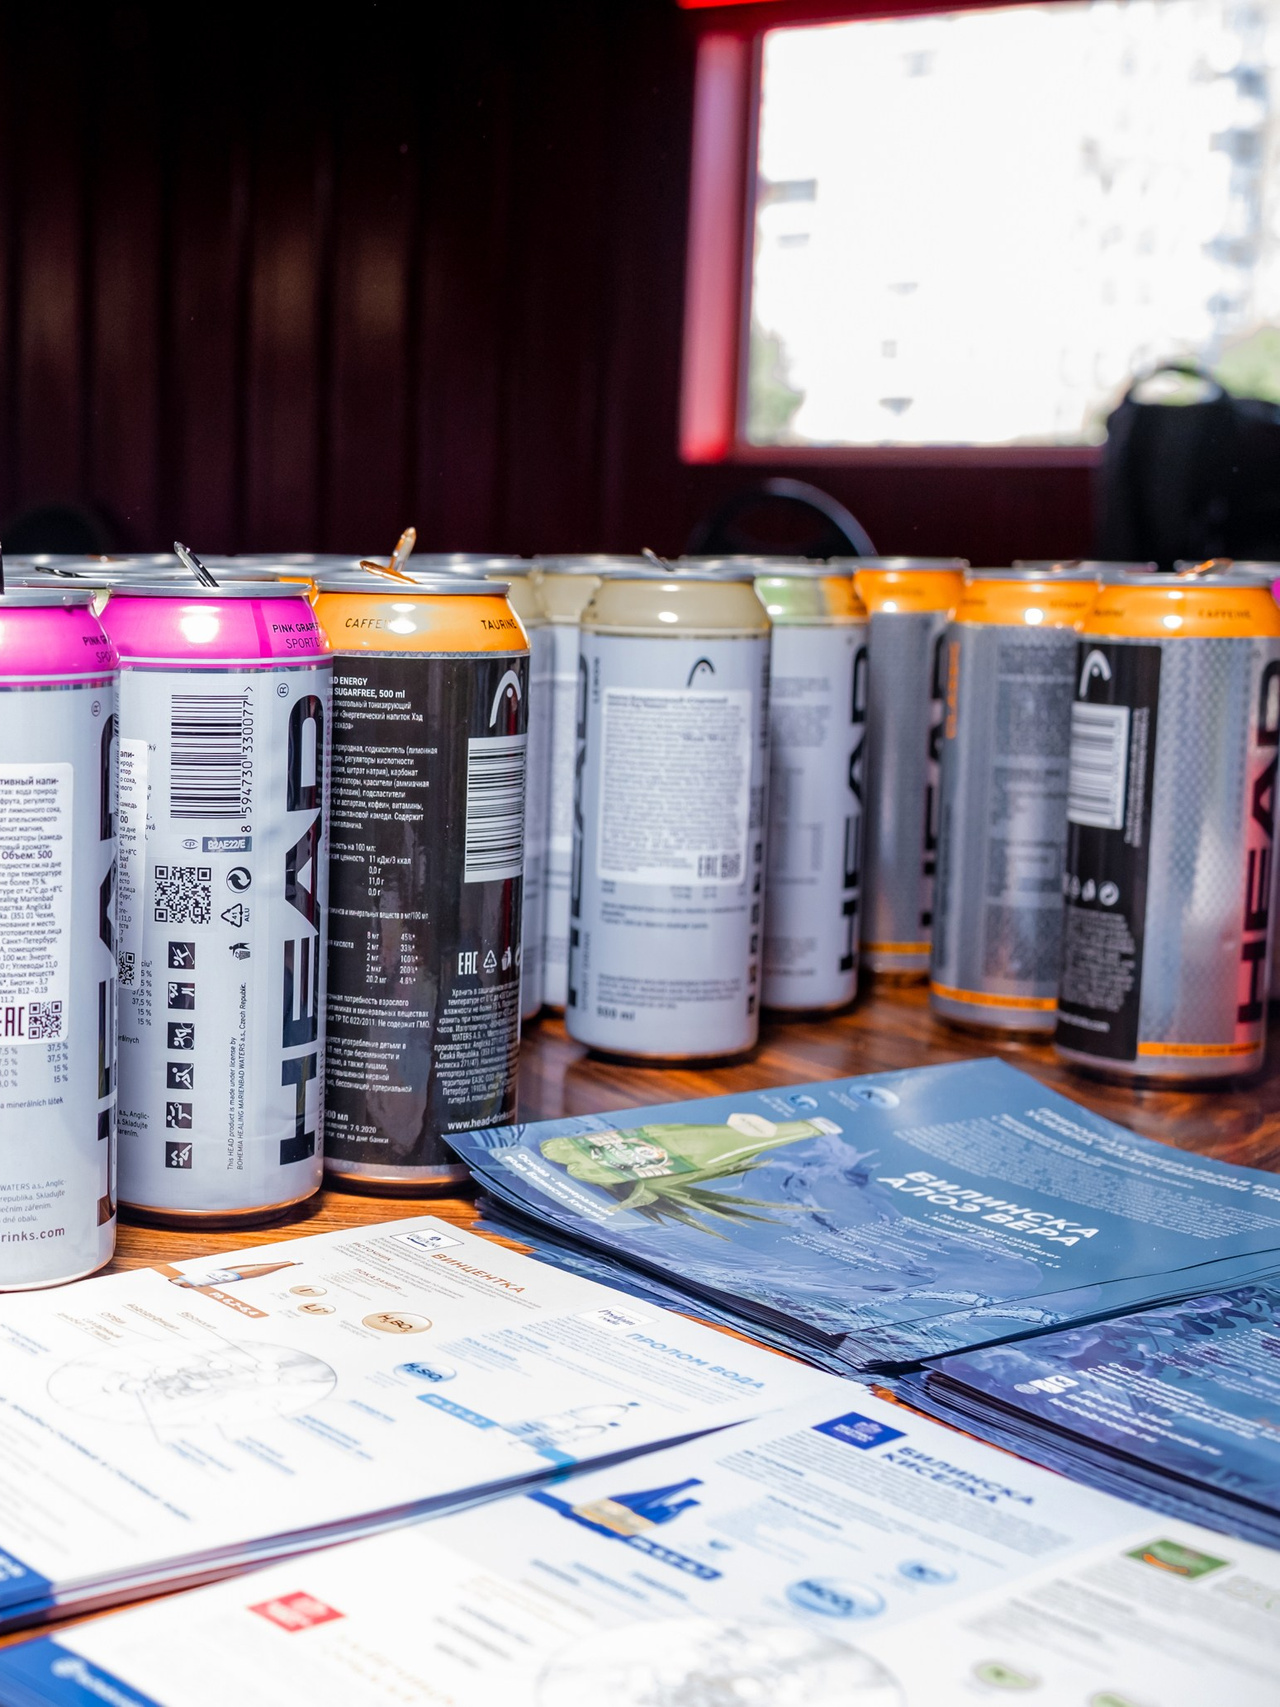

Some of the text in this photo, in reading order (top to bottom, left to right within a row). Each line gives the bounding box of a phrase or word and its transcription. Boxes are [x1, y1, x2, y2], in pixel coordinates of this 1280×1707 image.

[272, 621, 319, 633] PINK GRAPE
[345, 618, 391, 629] CAFFE
[481, 619, 518, 630] TAURINE
[286, 638, 314, 650] SPORT
[340, 676, 368, 686] ENERGY
[334, 687, 405, 699] SUGARFREE, 500 ml
[241, 700, 254, 833] 8 594730 330077
[2, 850, 53, 860] Объем: 500
[279, 694, 324, 1166] HEAD
[239, 983, 247, 1010] Republic.
[228, 1114, 236, 1137] product
[227, 1138, 235, 1156] HEAD
[0, 1182, 30, 1192] WATERS
[876, 1176, 981, 1213] АЛОЭ
[981, 1212, 1081, 1247] ВЕРА
[904, 1170, 1100, 1239] БИЛИНСКА
[431, 1252, 526, 1294] ВИНЦЕНТКА
[626, 1333, 765, 1390] ПРОЛОМ ВОДА
